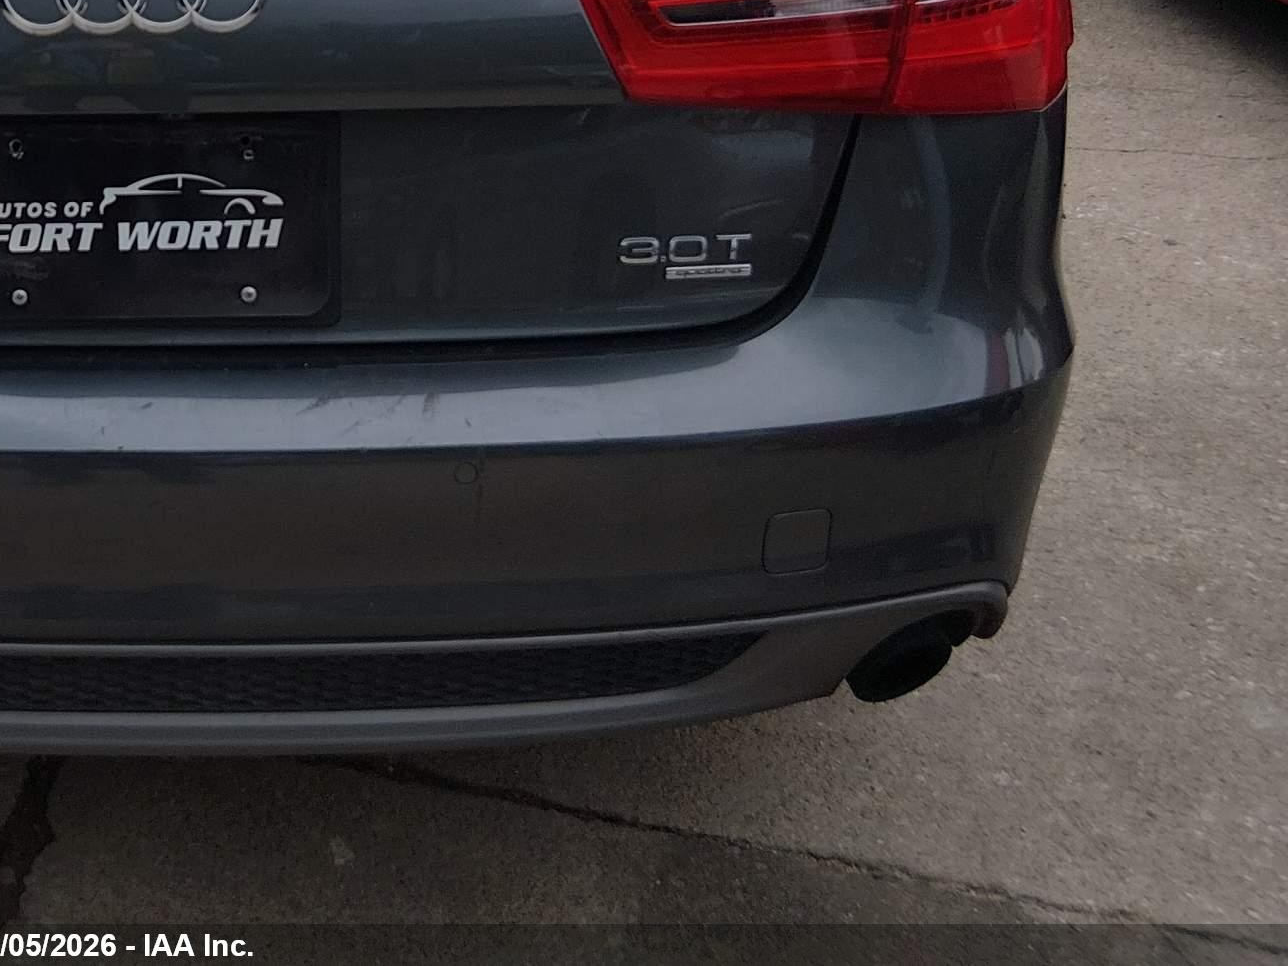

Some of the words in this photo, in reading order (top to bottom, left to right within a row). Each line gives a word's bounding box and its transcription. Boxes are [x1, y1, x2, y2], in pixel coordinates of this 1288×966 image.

[63, 201, 94, 218] OF
[117, 218, 284, 251] WORTH
[618, 233, 753, 265] 3.0T
